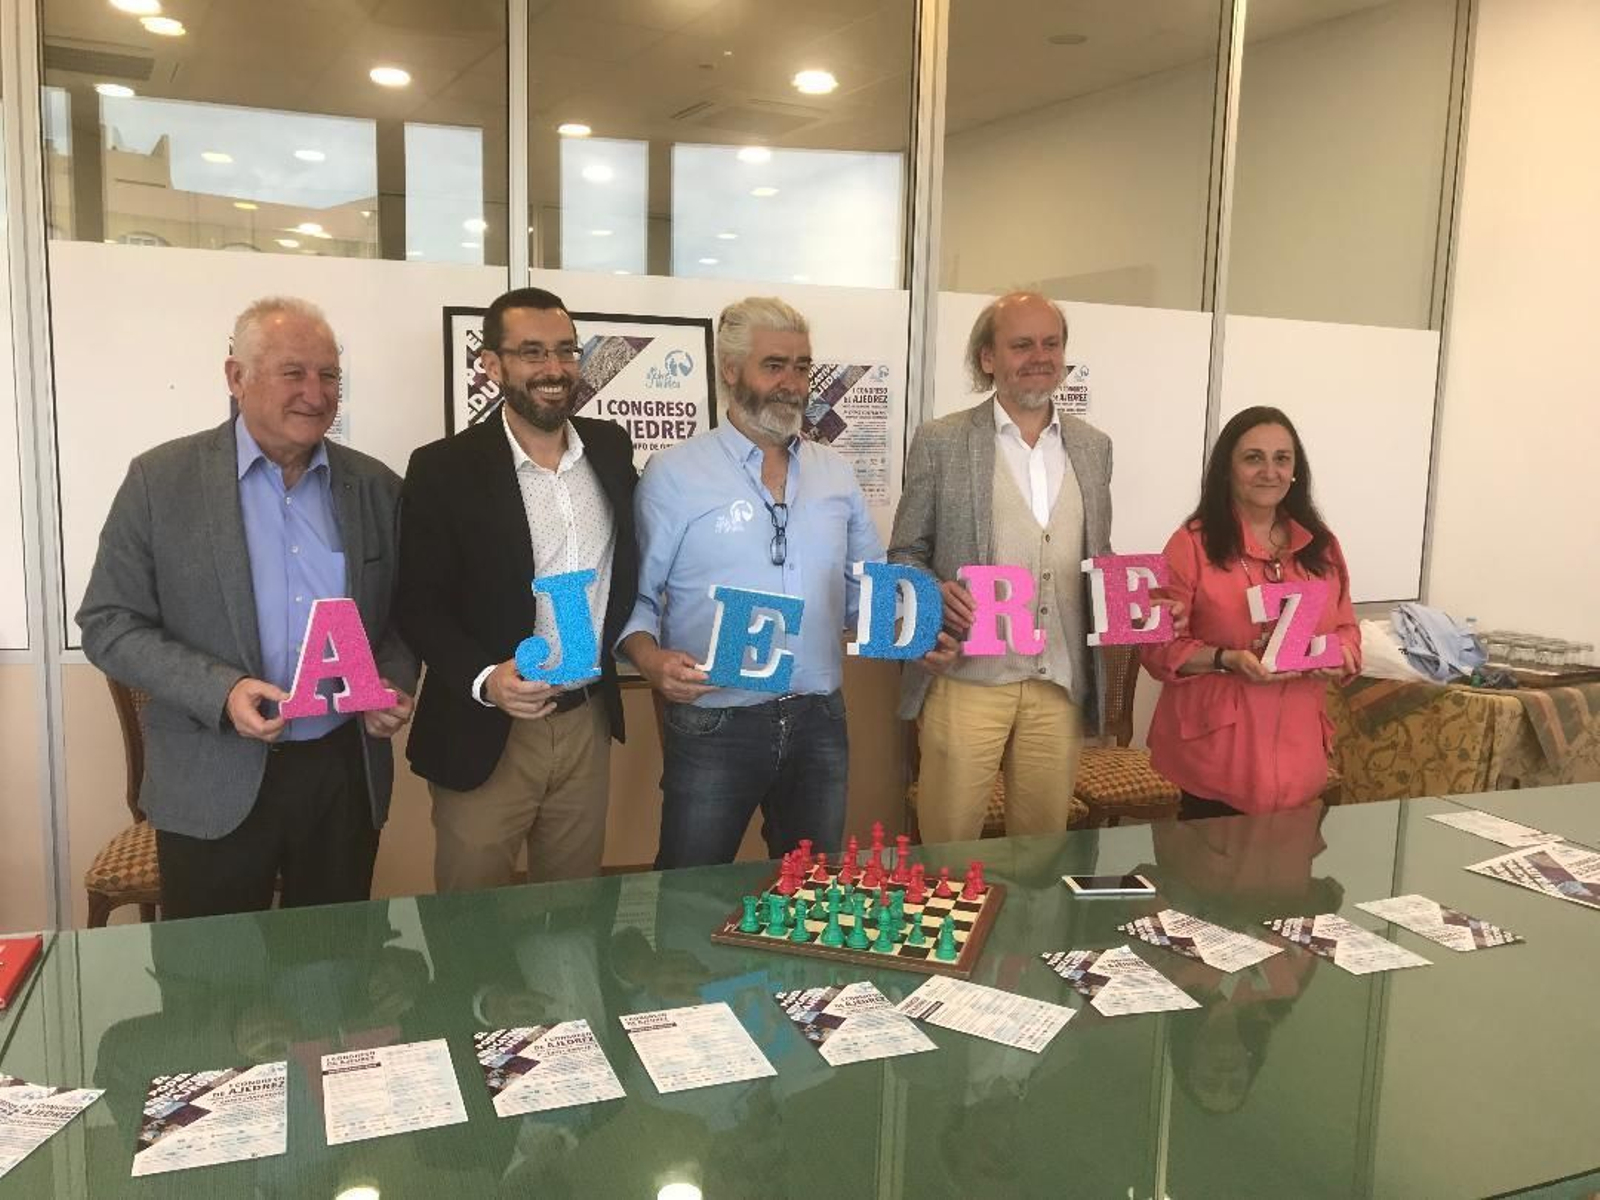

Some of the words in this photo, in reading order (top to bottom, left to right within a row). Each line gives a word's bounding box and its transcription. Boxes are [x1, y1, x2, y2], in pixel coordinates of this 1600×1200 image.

[597, 399, 602, 416] I
[606, 400, 697, 418] CONGRESO
[853, 395, 888, 404] AJEDREZ
[626, 419, 697, 440] JEDREZ
[279, 598, 398, 719] A
[515, 569, 602, 687] J
[695, 584, 806, 693] E
[847, 561, 945, 661] D
[957, 565, 1046, 657] R
[1081, 554, 1177, 648] E
[1247, 582, 1344, 673] Z
[228, 1080, 286, 1095] AJEDREZ
